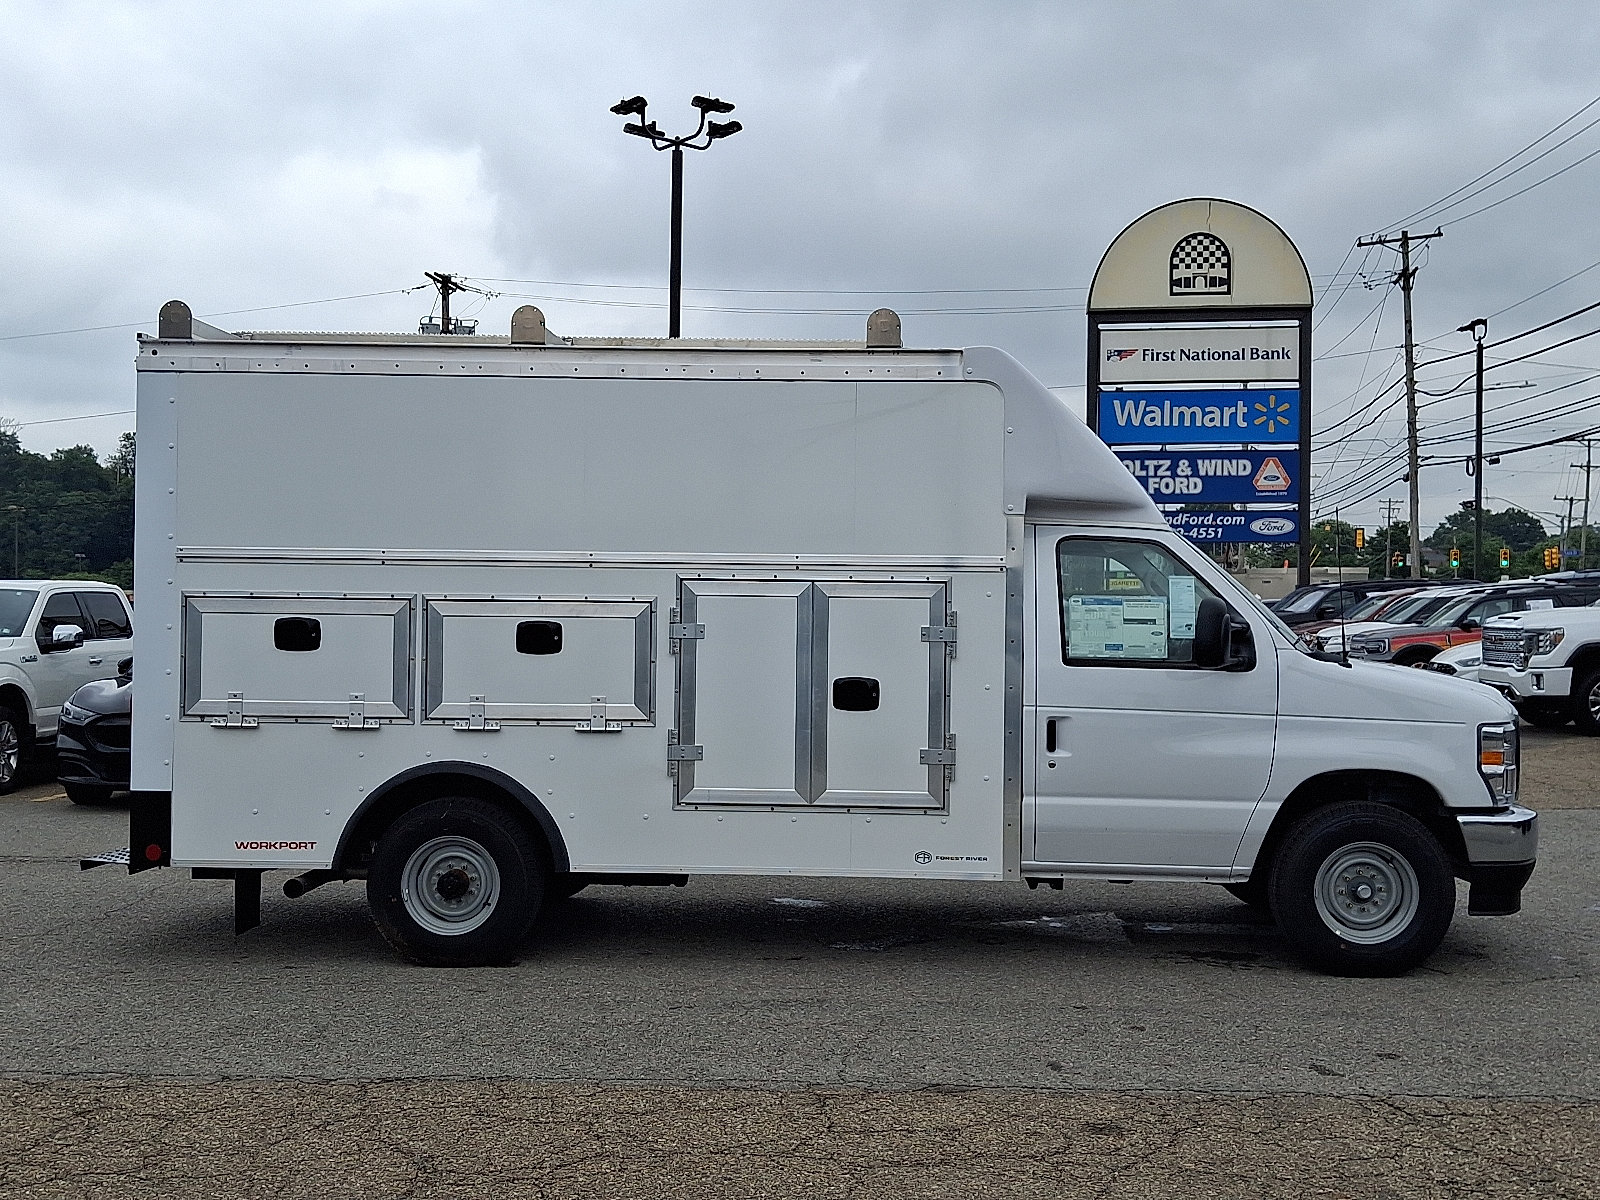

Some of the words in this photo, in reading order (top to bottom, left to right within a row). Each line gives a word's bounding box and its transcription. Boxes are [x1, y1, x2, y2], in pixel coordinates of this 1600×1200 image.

[1142, 348, 1175, 361] First
[1180, 348, 1246, 361] National
[1250, 347, 1291, 360] Bank
[1113, 399, 1248, 427] Walmart
[1176, 459, 1193, 476] &
[1197, 459, 1252, 476] WIND
[1148, 477, 1203, 494] FORD
[1163, 513, 1245, 525] ndFord.com
[1259, 520, 1286, 532] Ford
[234, 841, 317, 850] WORKPORT
